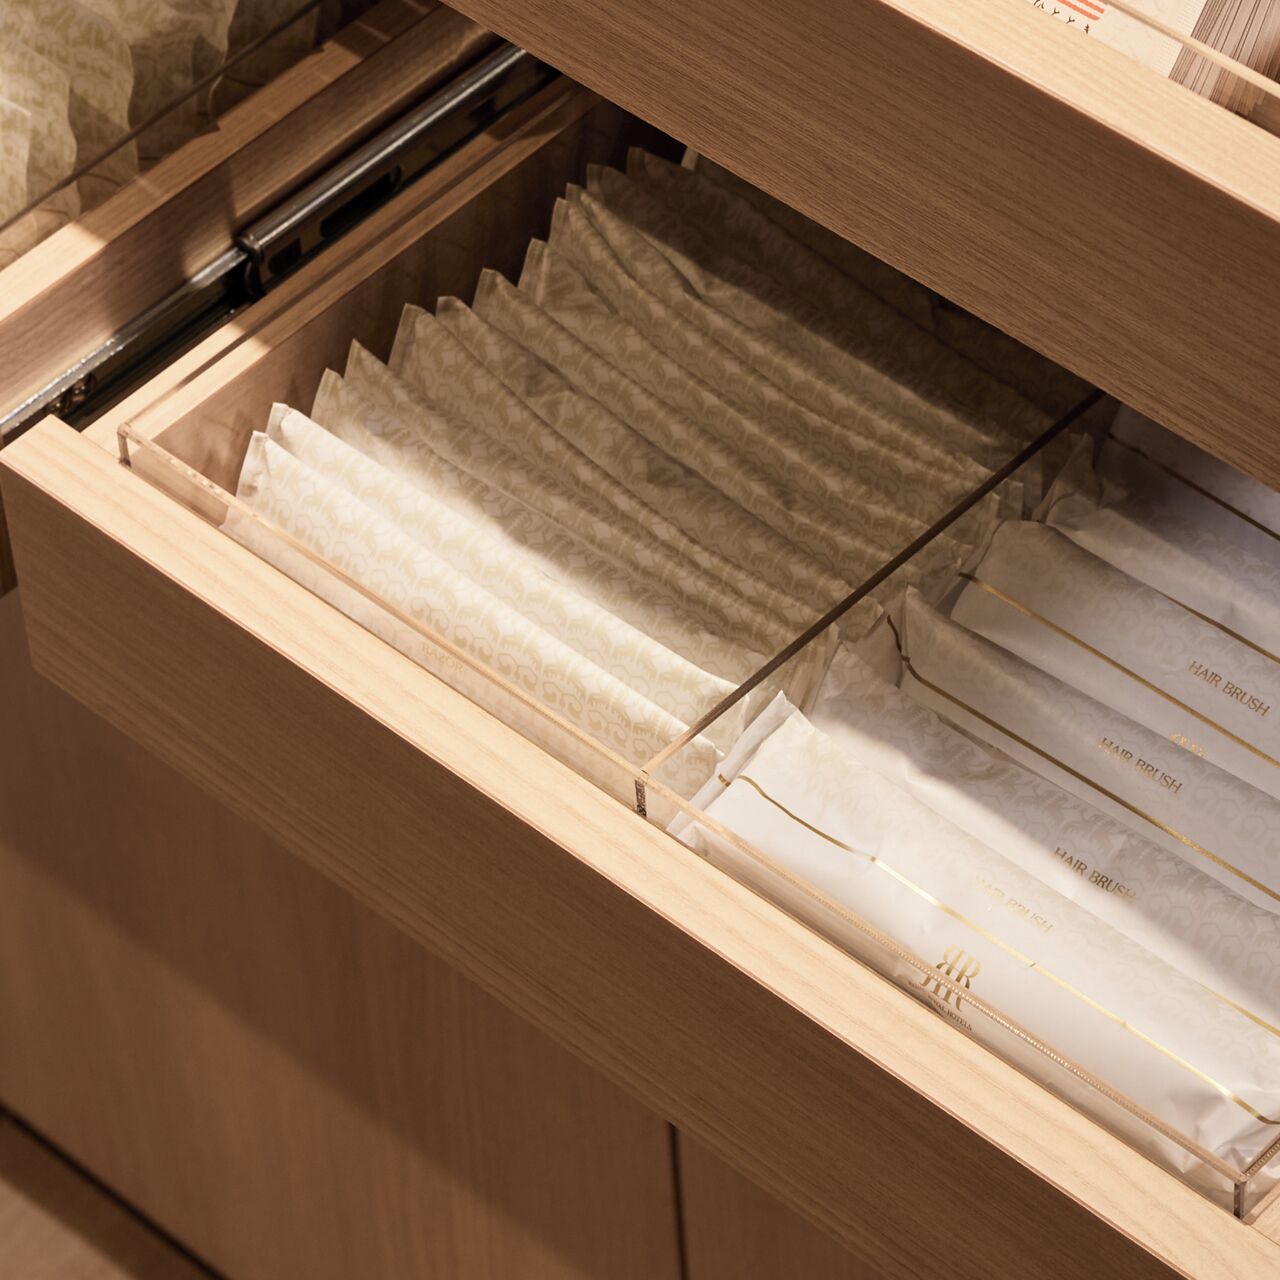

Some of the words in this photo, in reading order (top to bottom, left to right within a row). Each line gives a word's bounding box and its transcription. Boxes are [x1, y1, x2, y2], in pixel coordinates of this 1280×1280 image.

[1187, 660, 1223, 688] HAIR
[1222, 681, 1271, 717] BRUSH
[1098, 736, 1134, 764] HAIR
[1135, 757, 1184, 794] BRUSH
[1053, 846, 1088, 877] HAIR
[1088, 869, 1138, 904] BRUSH
[974, 875, 1006, 904] HAIR
[1006, 897, 1055, 935] BRUSH
